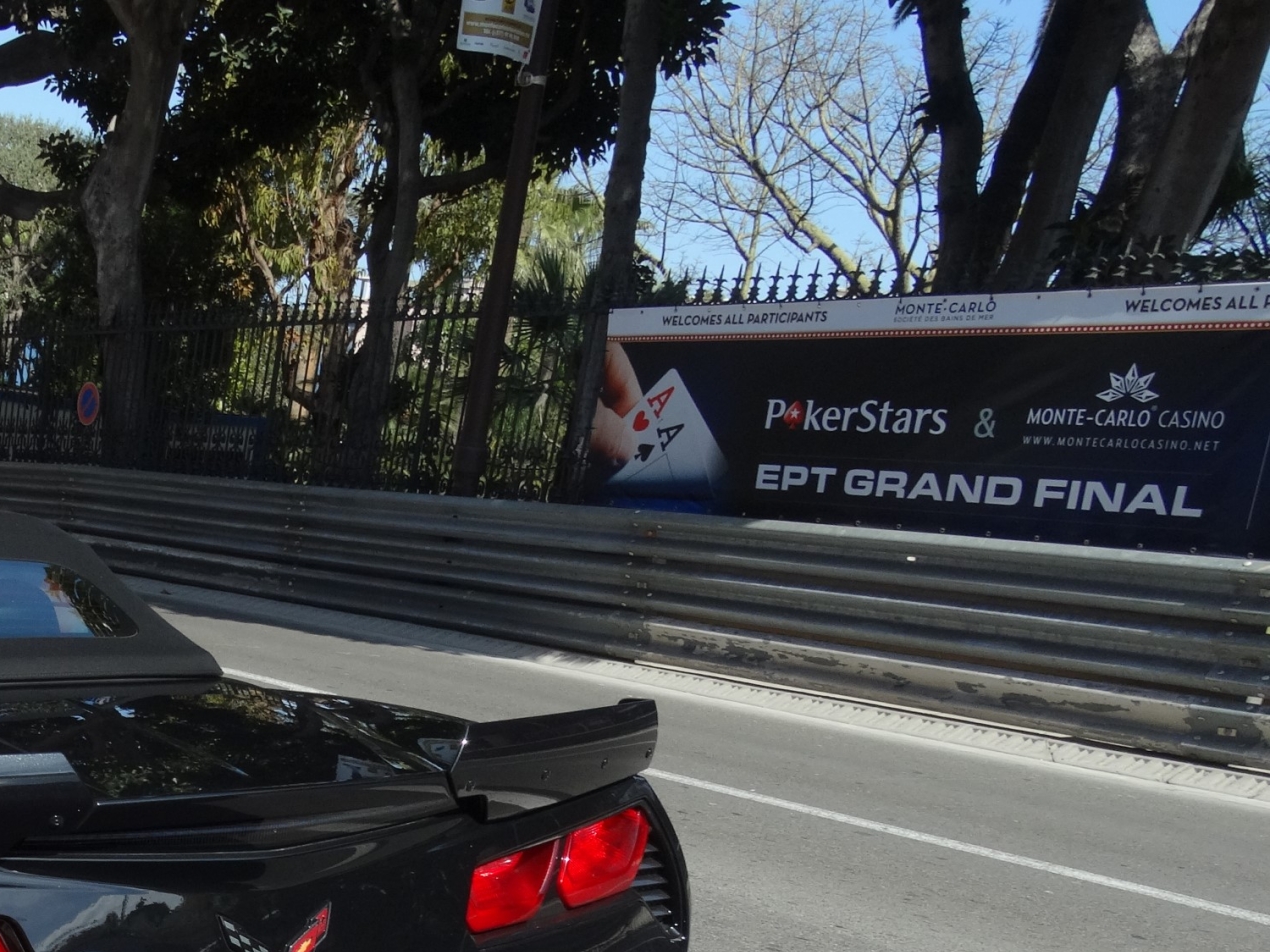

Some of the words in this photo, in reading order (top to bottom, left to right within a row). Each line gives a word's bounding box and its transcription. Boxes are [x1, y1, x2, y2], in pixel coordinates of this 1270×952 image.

[1125, 296, 1222, 313] WELCOMES
[1225, 295, 1258, 310] ALL
[662, 314, 723, 326] WELCOMES
[724, 313, 744, 325] ALL
[747, 310, 828, 325] PARTICIPANTS
[973, 407, 995, 438] &
[1157, 410, 1225, 429] CASINO
[1022, 435, 1221, 452] WWW.MONTECARLOCASINO.NET
[755, 464, 837, 493] EPT
[843, 469, 1023, 506] GRAND
[1033, 478, 1204, 518] FINAL
